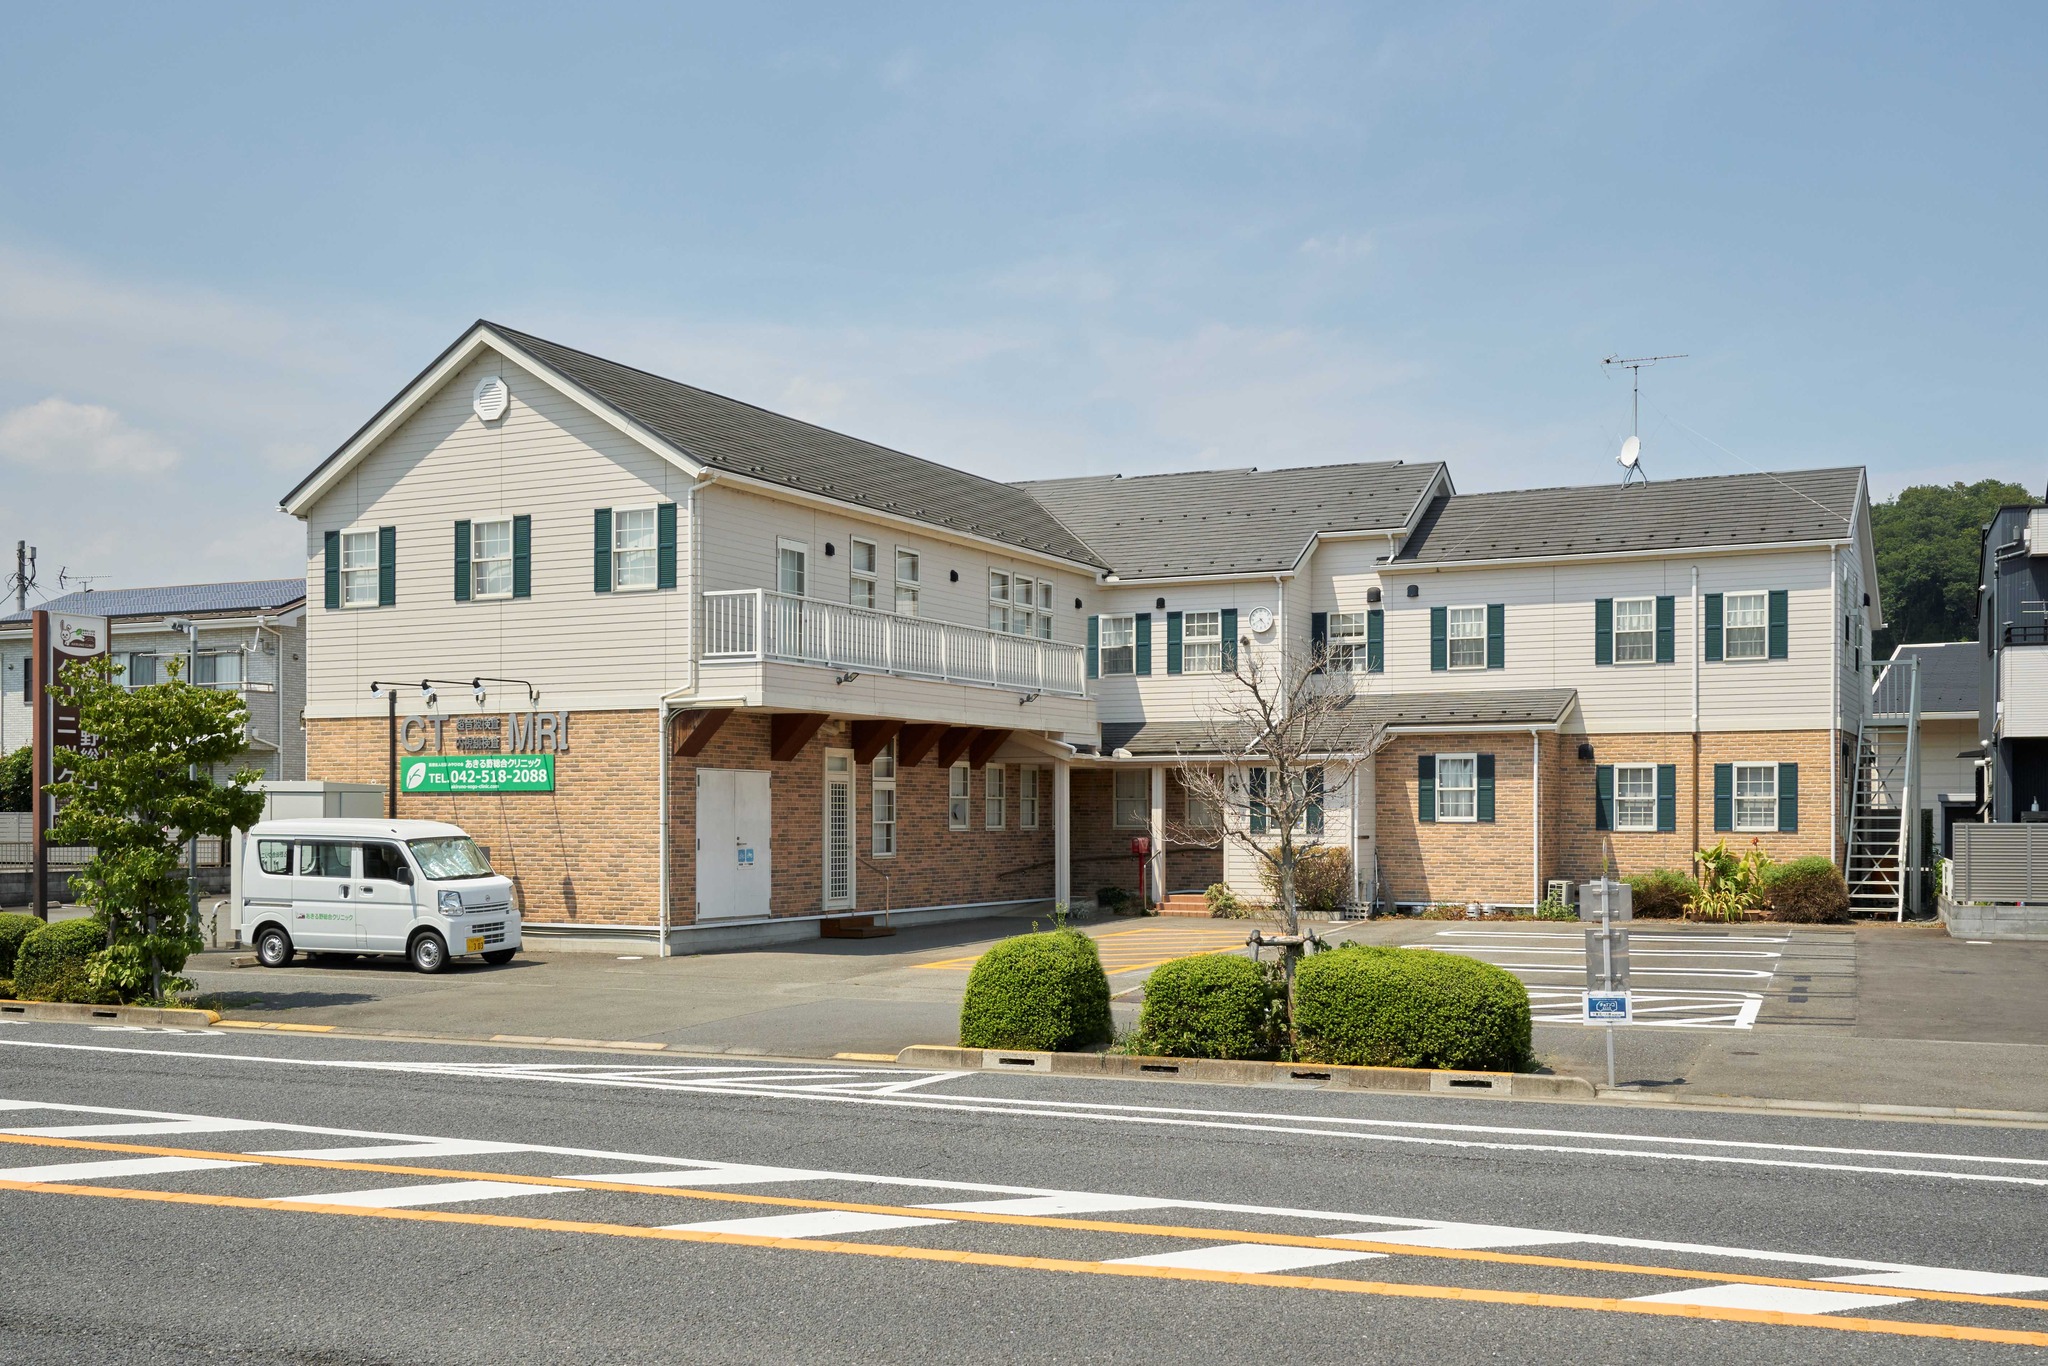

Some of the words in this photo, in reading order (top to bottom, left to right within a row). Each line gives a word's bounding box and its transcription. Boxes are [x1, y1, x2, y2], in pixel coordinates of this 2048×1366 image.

[456, 716, 500, 731] 超音波検査
[400, 714, 450, 752] CT
[508, 711, 568, 751] MRI
[465, 758, 542, 769] あきる野総合クリニック
[428, 773, 450, 783] TEL.
[450, 769, 548, 783] 042-518-2088
[305, 912, 354, 921] あきる野総合クリニック
